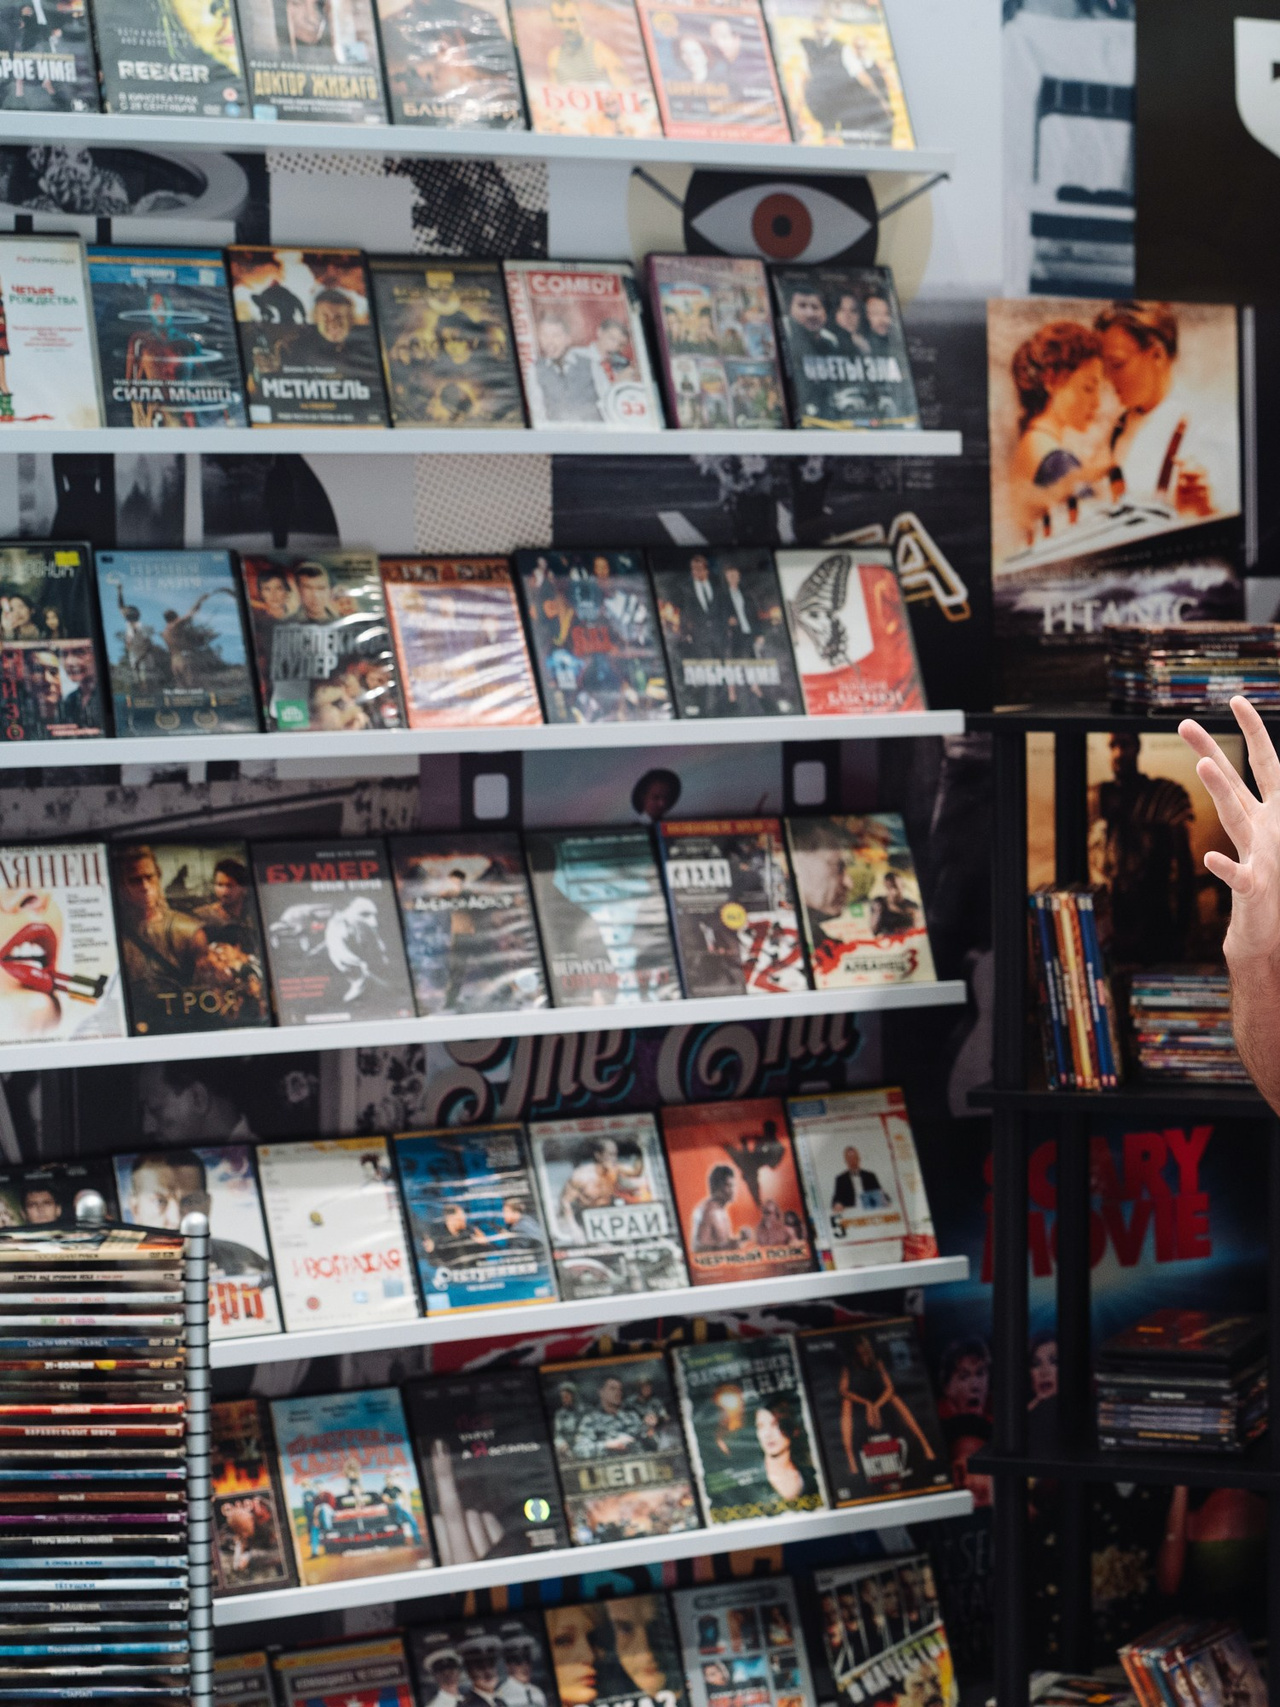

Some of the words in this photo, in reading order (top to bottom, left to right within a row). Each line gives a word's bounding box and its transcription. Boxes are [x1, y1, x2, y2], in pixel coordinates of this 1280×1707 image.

[0, 58, 34, 81] РОЕ
[117, 60, 211, 84] REEKER
[254, 70, 307, 96] ДОКТОР
[311, 73, 378, 100] ЖИВАГО
[531, 273, 617, 296] COMEDY
[112, 386, 164, 402] СИЛА
[261, 377, 371, 400] МСТИТЕЛЬ
[1041, 598, 1199, 634] TITANIC
[266, 859, 380, 885] БУМЕР
[156, 988, 239, 1017] ТРОЯ
[983, 1125, 1214, 1216] CARY
[577, 1460, 674, 1491] ЦЕПЬ
